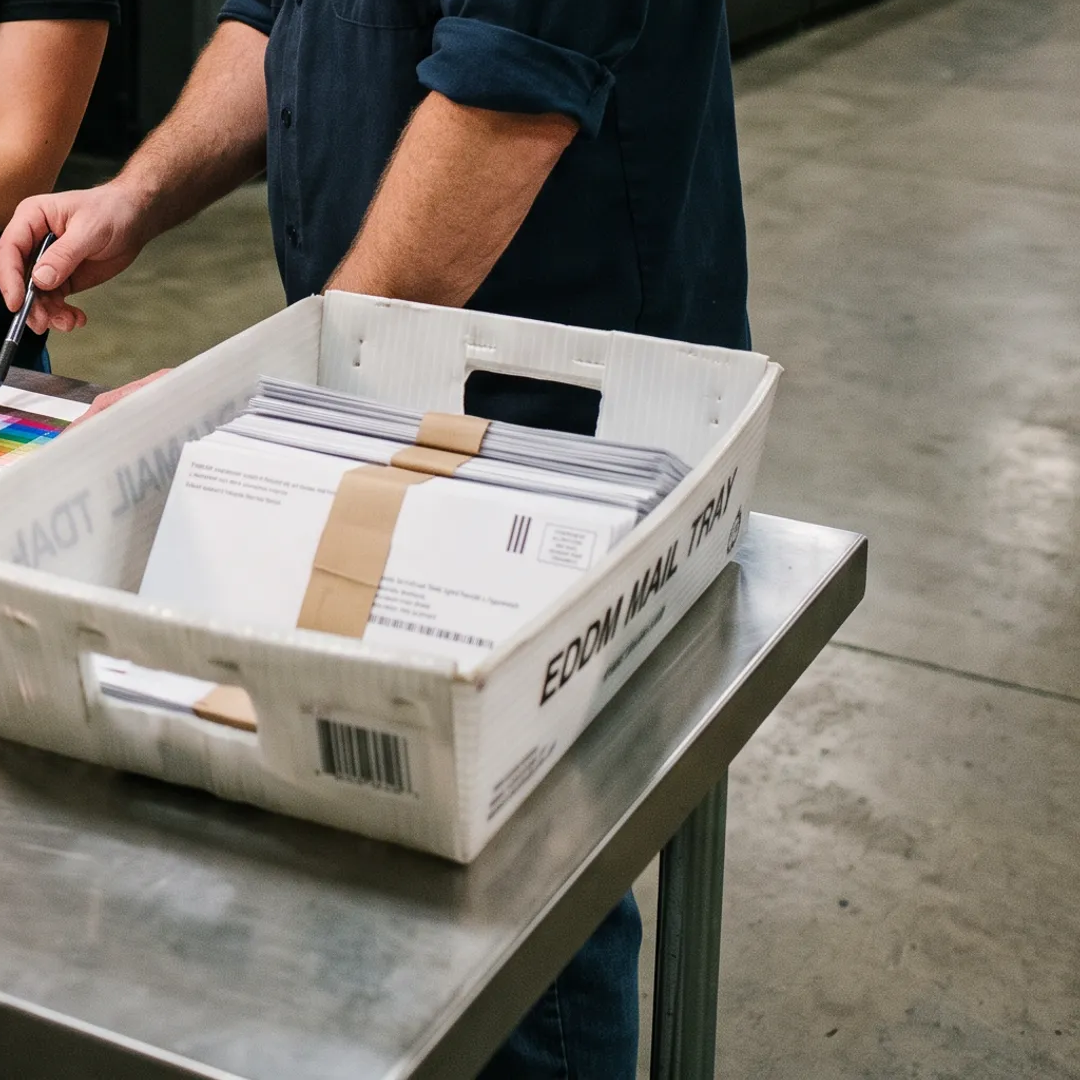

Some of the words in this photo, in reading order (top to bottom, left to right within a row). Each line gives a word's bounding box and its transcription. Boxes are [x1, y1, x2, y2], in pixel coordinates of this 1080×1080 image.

[539, 595, 624, 707] EDDM
[624, 539, 679, 626] MAIL
[687, 465, 739, 557] TRAY
